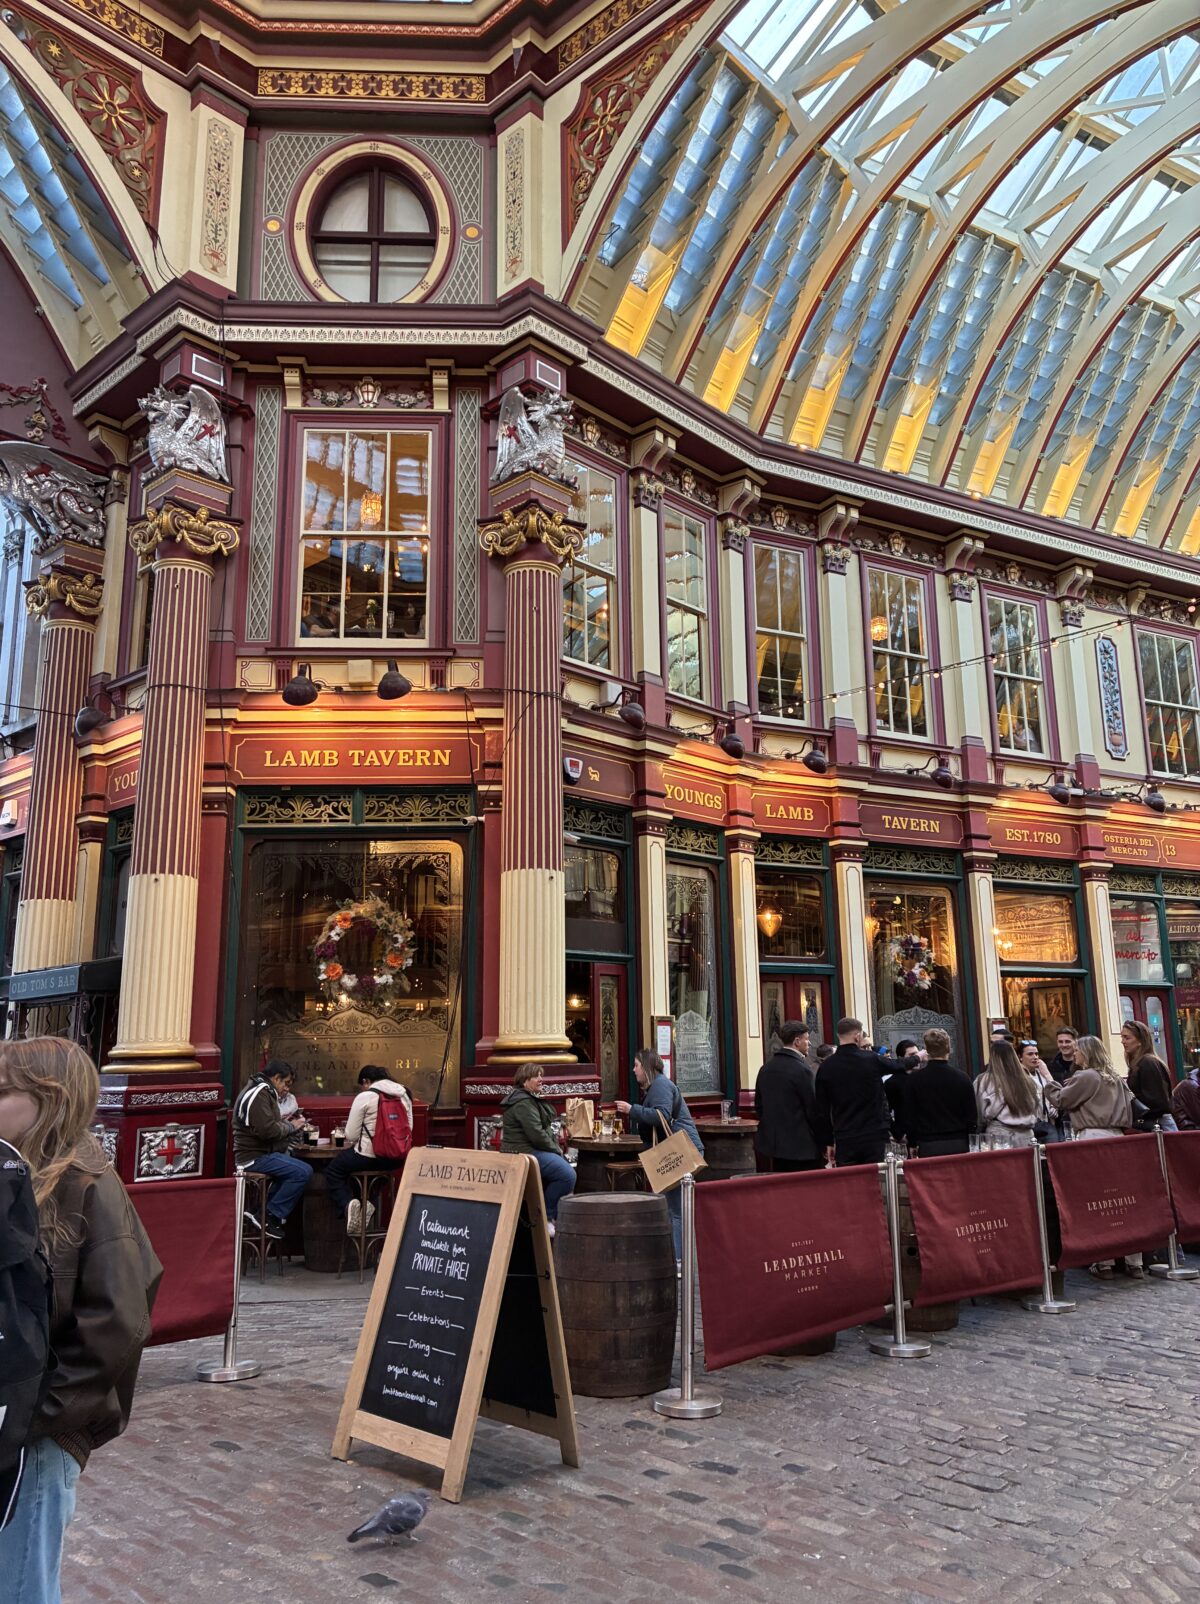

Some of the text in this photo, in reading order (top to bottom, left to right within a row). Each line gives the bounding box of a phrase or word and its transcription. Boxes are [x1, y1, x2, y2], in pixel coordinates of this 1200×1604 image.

[263, 749, 452, 768] LAMB TAVERN
[114, 769, 139, 792] YOU
[664, 783, 723, 811] YOUNGS
[765, 803, 815, 822] LAMB
[881, 815, 941, 834] TAVERN
[1004, 828, 1062, 846] EST.1780
[1104, 834, 1154, 848] OSTERIA DEL
[1111, 846, 1148, 857] MERCATO
[1165, 844, 1177, 857] 13
[11, 980, 28, 994] OLD
[57, 973, 76, 988] BAR
[327, 1060, 361, 1071] AND
[418, 1163, 507, 1185] LAMB TAVERN
[1086, 1195, 1136, 1211] LEADENHALL
[418, 1209, 470, 1240] Restaurant
[955, 1217, 1009, 1238] LEADENHALL
[411, 1252, 470, 1282] PRIVATE HIRE!
[763, 1249, 845, 1273] LEADENHALL
[784, 1265, 828, 1281] MARKET
[420, 1285, 445, 1299] Events
[408, 1311, 450, 1329] Celebrations
[408, 1338, 431, 1358] Dining
